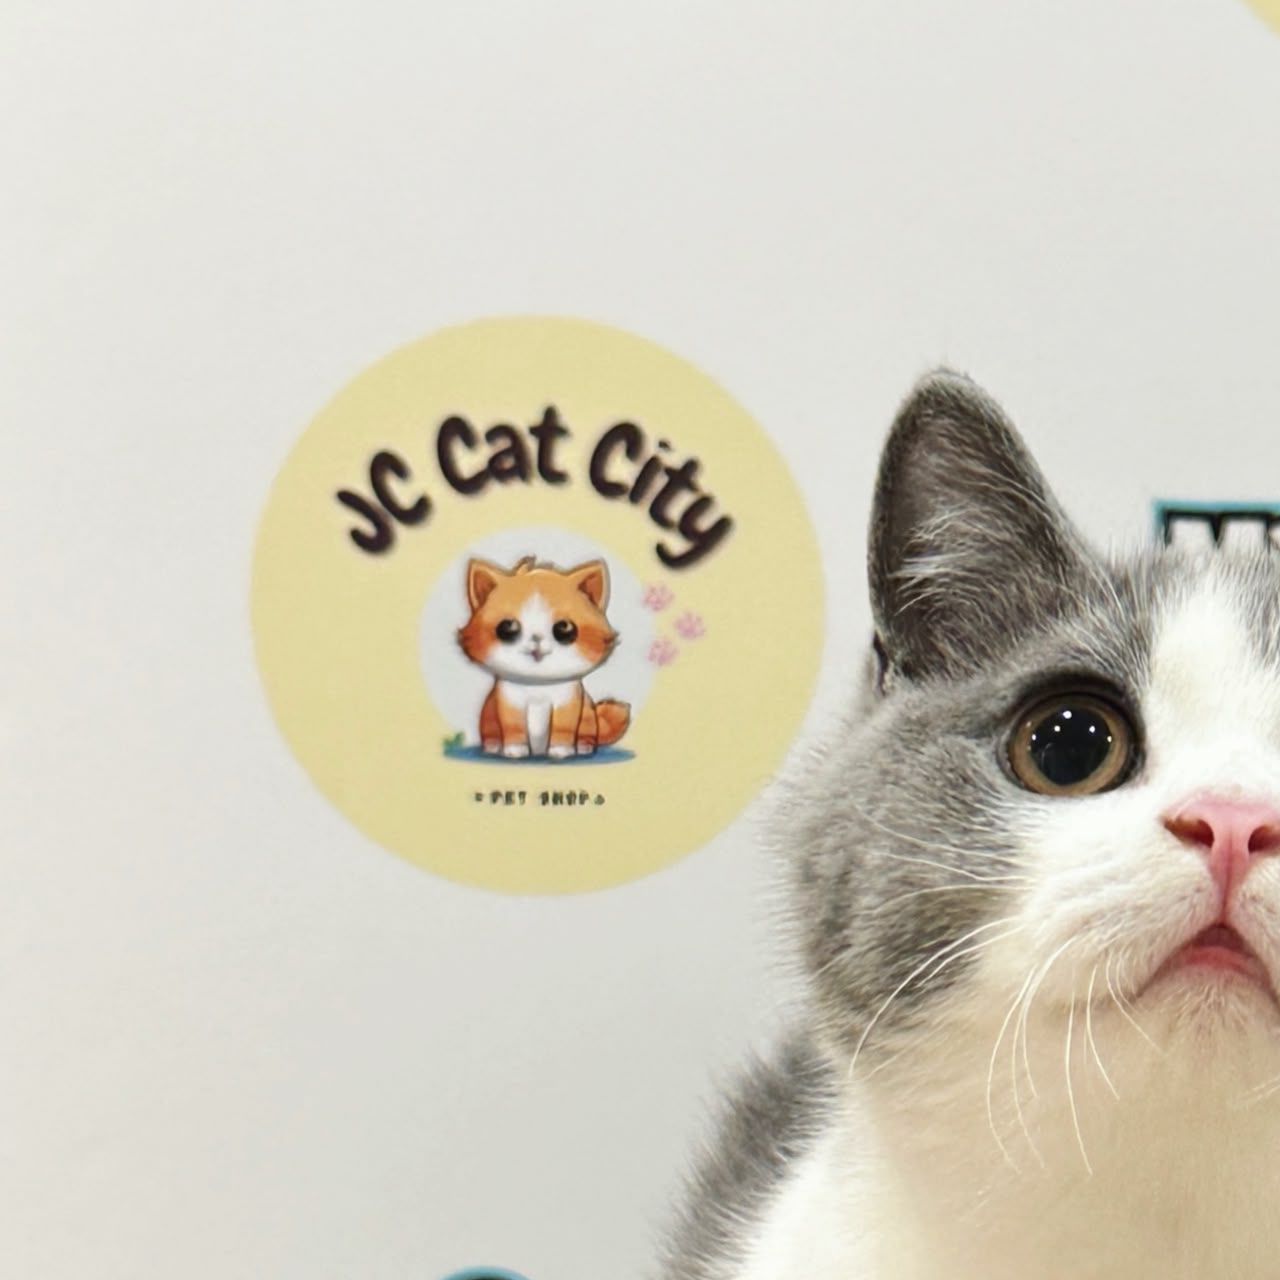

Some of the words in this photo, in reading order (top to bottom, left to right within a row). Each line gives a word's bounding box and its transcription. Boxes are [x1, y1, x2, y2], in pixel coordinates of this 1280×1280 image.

[335, 449, 434, 557] JC
[435, 405, 570, 497] Cat
[588, 420, 734, 571] City
